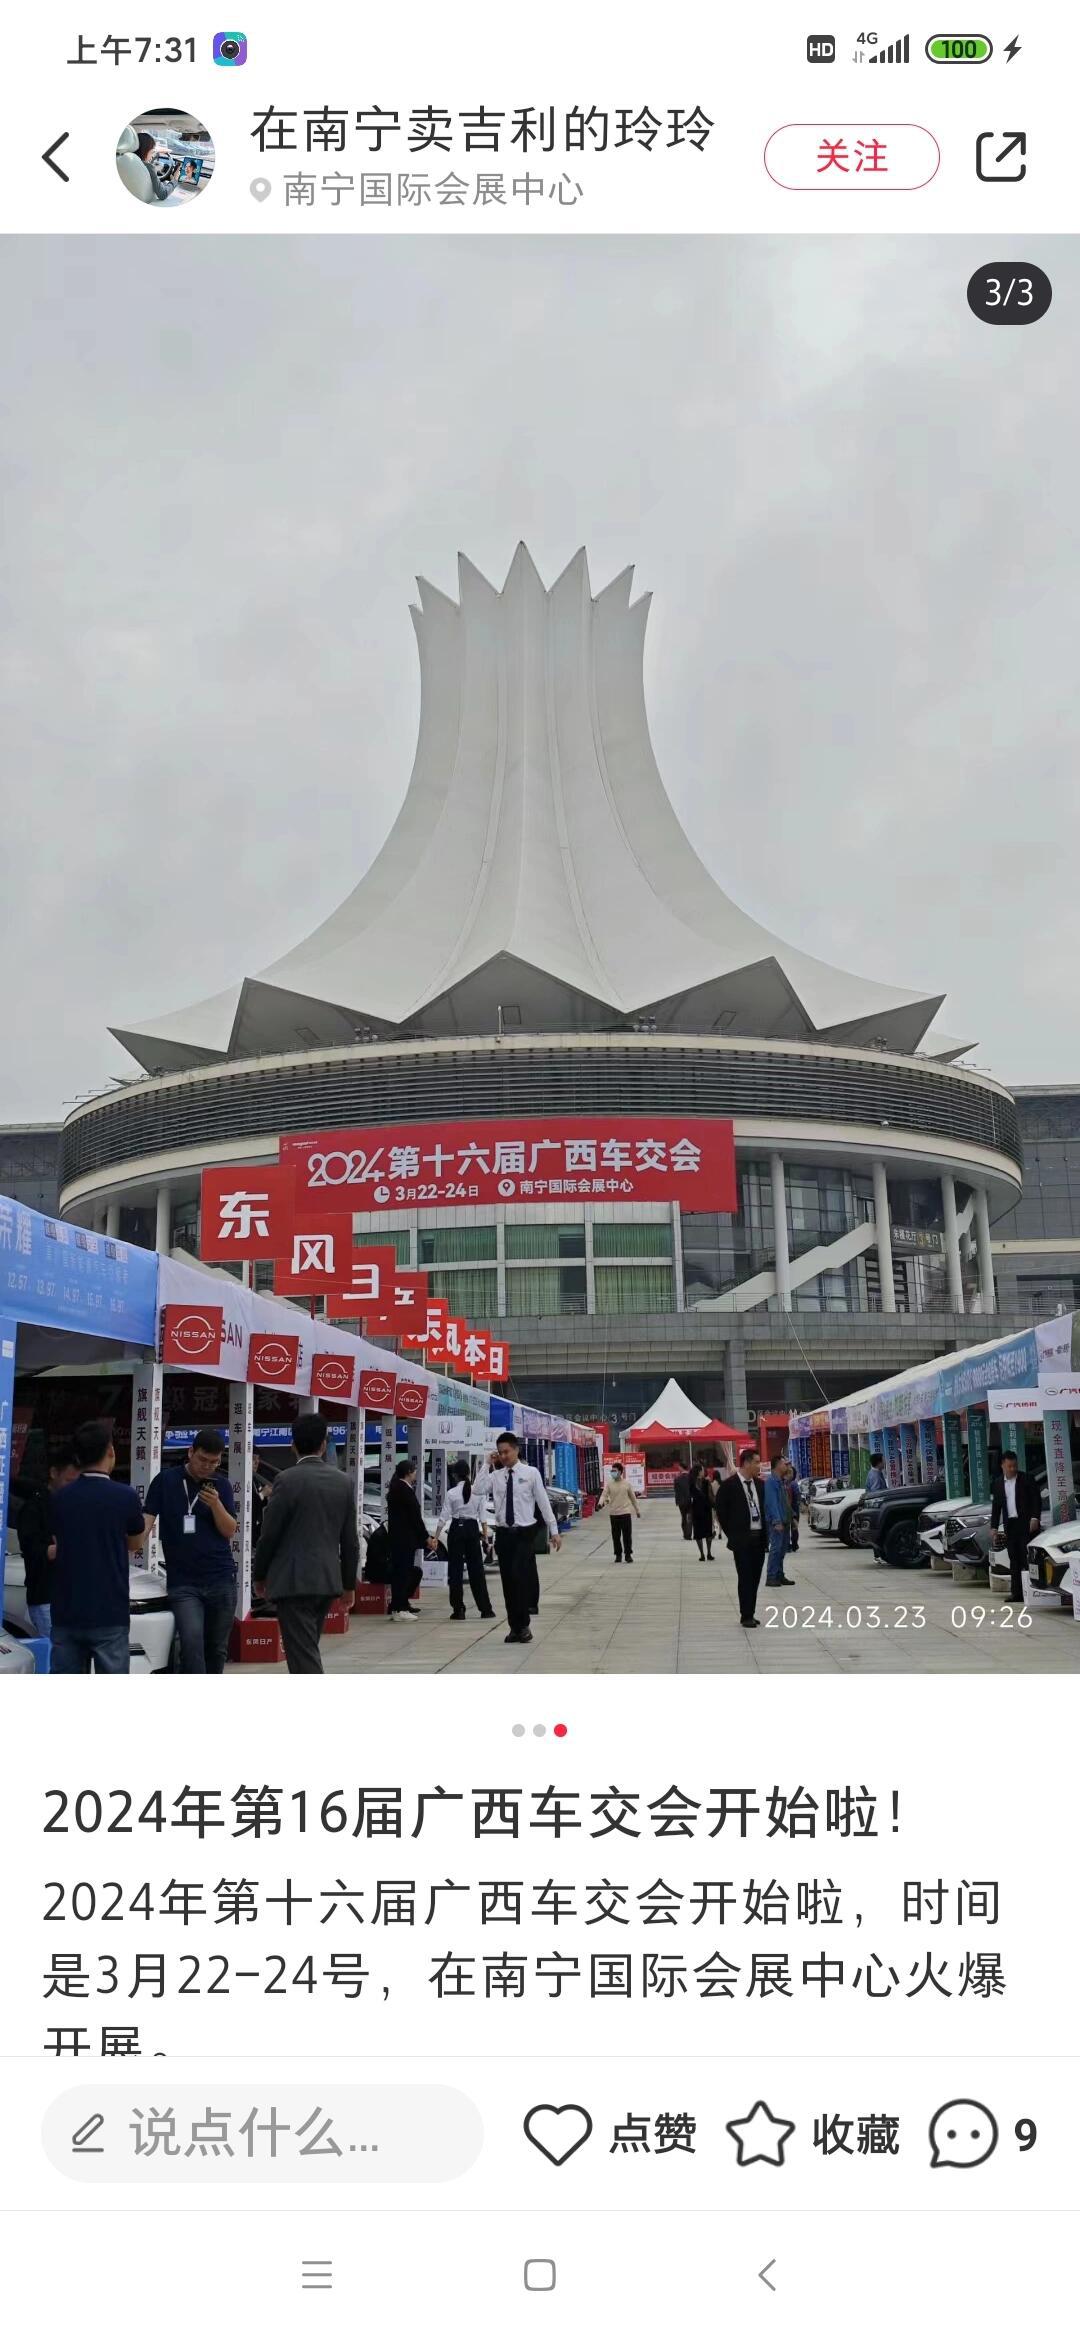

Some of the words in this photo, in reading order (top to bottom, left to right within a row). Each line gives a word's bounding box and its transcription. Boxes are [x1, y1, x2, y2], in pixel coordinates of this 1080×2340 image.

[67, 35, 195, 65] 上午7:31
[809, 42, 834, 57] HD
[856, 31, 878, 45] 4G
[941, 40, 977, 59] 100
[251, 104, 716, 153] 在南宁卖吉利的玲玲
[816, 138, 889, 173] 关注
[283, 171, 584, 207] 南宁国际会展中心
[307, 1138, 702, 1188] 2024第十六届广西车交会
[395, 1182, 480, 1202] 3月22-24日
[519, 1179, 634, 1195] 南宁国际会展中心
[218, 1191, 270, 1239] 东
[291, 1235, 336, 1275] 风
[171, 1329, 216, 1340] NISSAN
[253, 1354, 293, 1364] NISSAN
[316, 1371, 349, 1380] NISSAN
[363, 1385, 392, 1394] NISSAN
[398, 1397, 424, 1405] NISSAN
[42, 1878, 1000, 1929] 2024年第十六届广西车交会开始啦，时间
[42, 1951, 1008, 2002] 是3月22-24号，在南宁国际会展中心火爆
[43, 2027, 167, 2056] 开展
[129, 2106, 379, 2158] 说点什么...
[608, 2111, 697, 2155] 点赞
[812, 2113, 900, 2156] 收藏
[1014, 2118, 1038, 2152] 9
